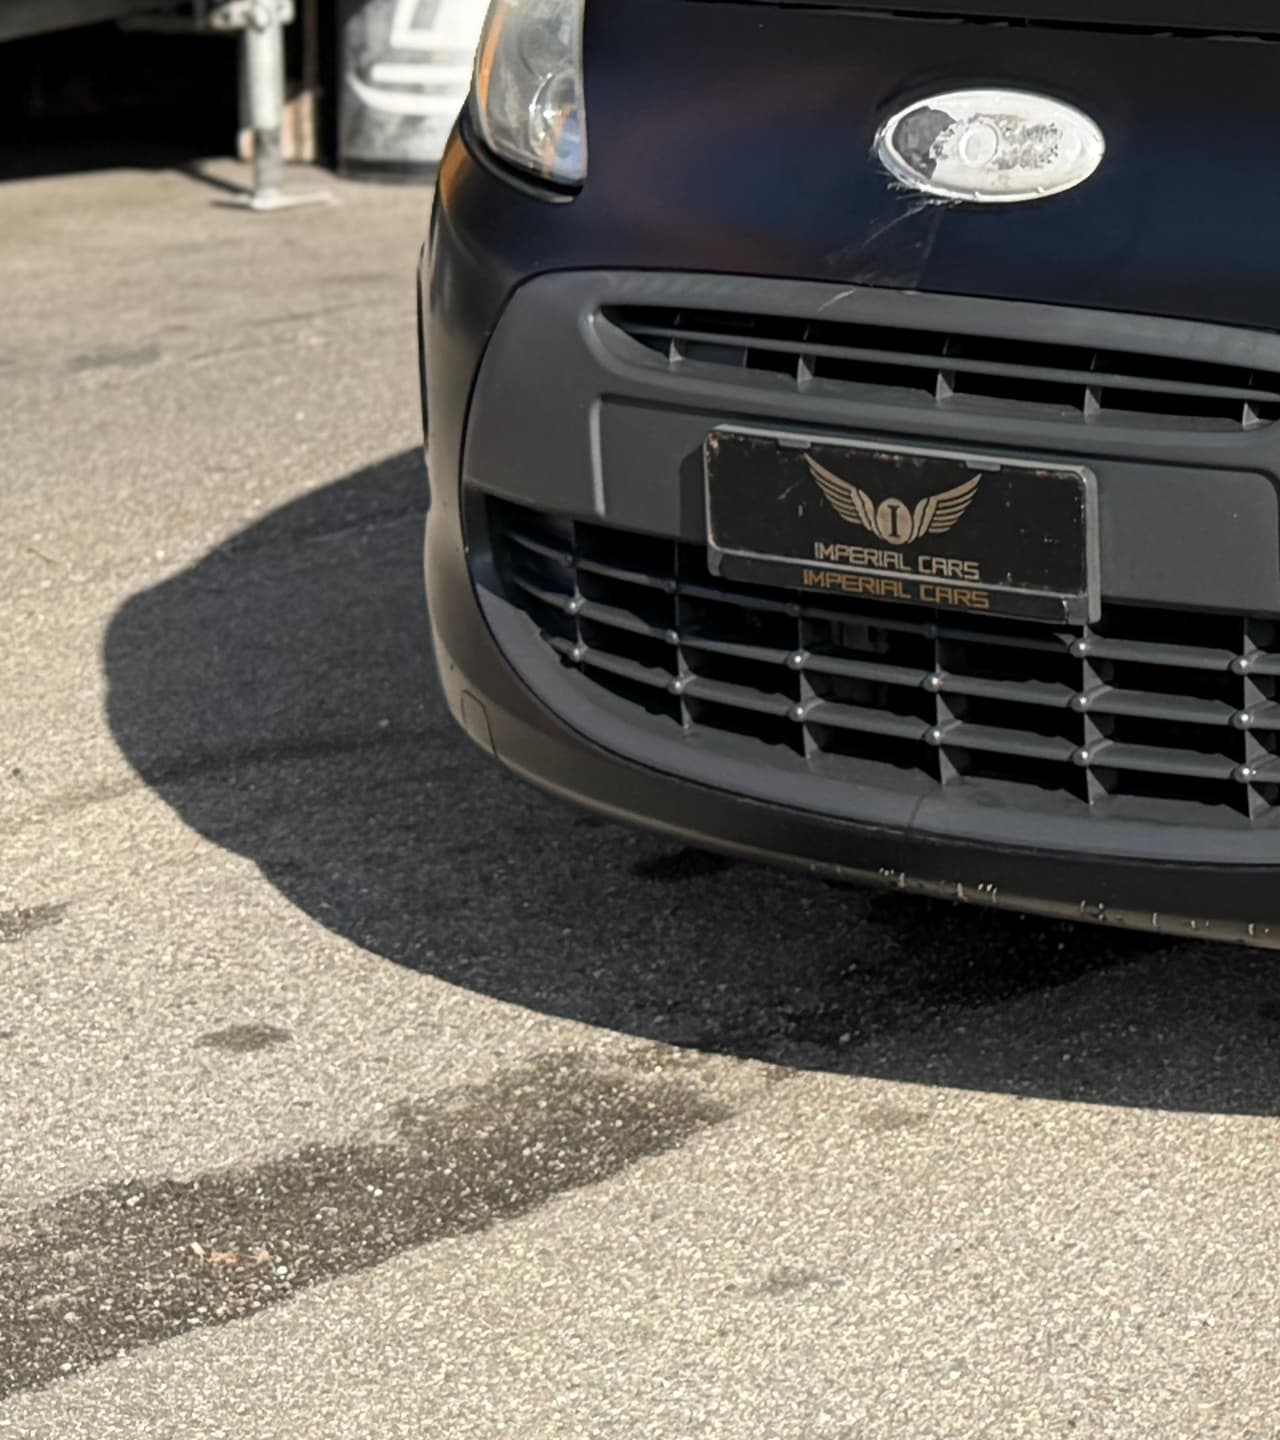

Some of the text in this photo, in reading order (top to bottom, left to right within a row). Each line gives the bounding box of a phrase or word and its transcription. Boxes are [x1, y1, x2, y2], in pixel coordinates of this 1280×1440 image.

[814, 541, 980, 581] IMPERIAL CARS
[803, 568, 990, 609] IMPERIAL CARS
